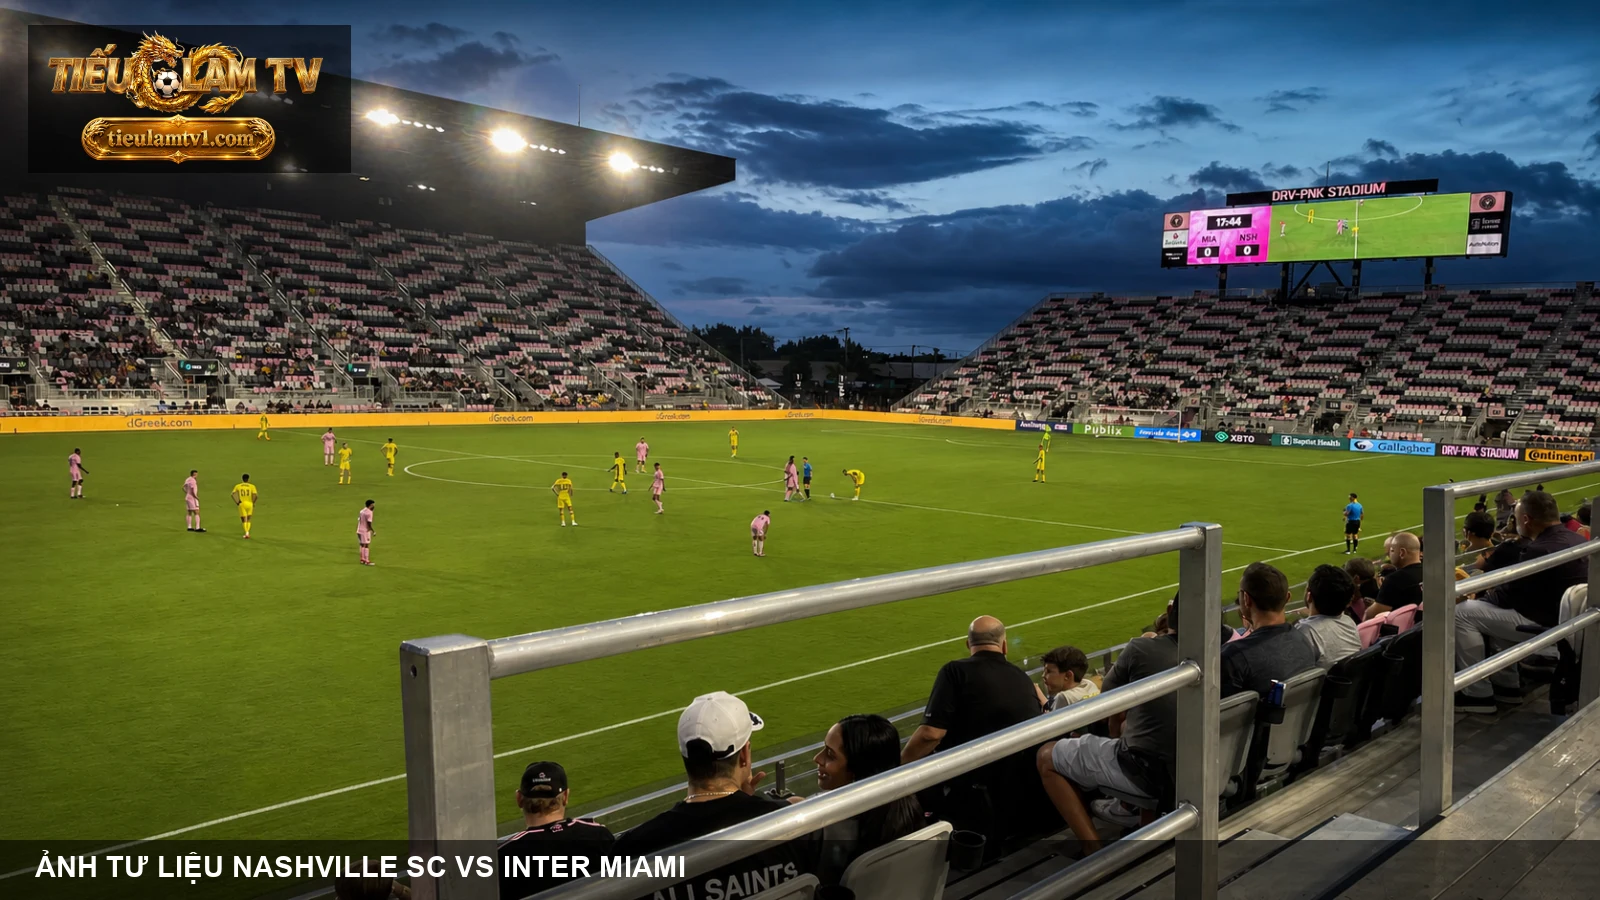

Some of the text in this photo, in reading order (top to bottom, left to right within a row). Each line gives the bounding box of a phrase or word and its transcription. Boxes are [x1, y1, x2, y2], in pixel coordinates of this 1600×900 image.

[1272, 182, 1387, 202] DRV-PNK STADIUM
[1215, 217, 1242, 227] 17:44
[1201, 235, 1217, 244] MIA
[1239, 233, 1258, 242] NSH
[1204, 247, 1212, 257] 0
[1243, 245, 1252, 256] 0
[1084, 424, 1122, 435] Publix
[1230, 435, 1255, 443] XBTO
[1317, 439, 1341, 447] Health
[1378, 442, 1431, 454] Gallagher
[1441, 444, 1519, 460] DRV-PNK STADIUM
[705, 861, 798, 900] SAINTS
